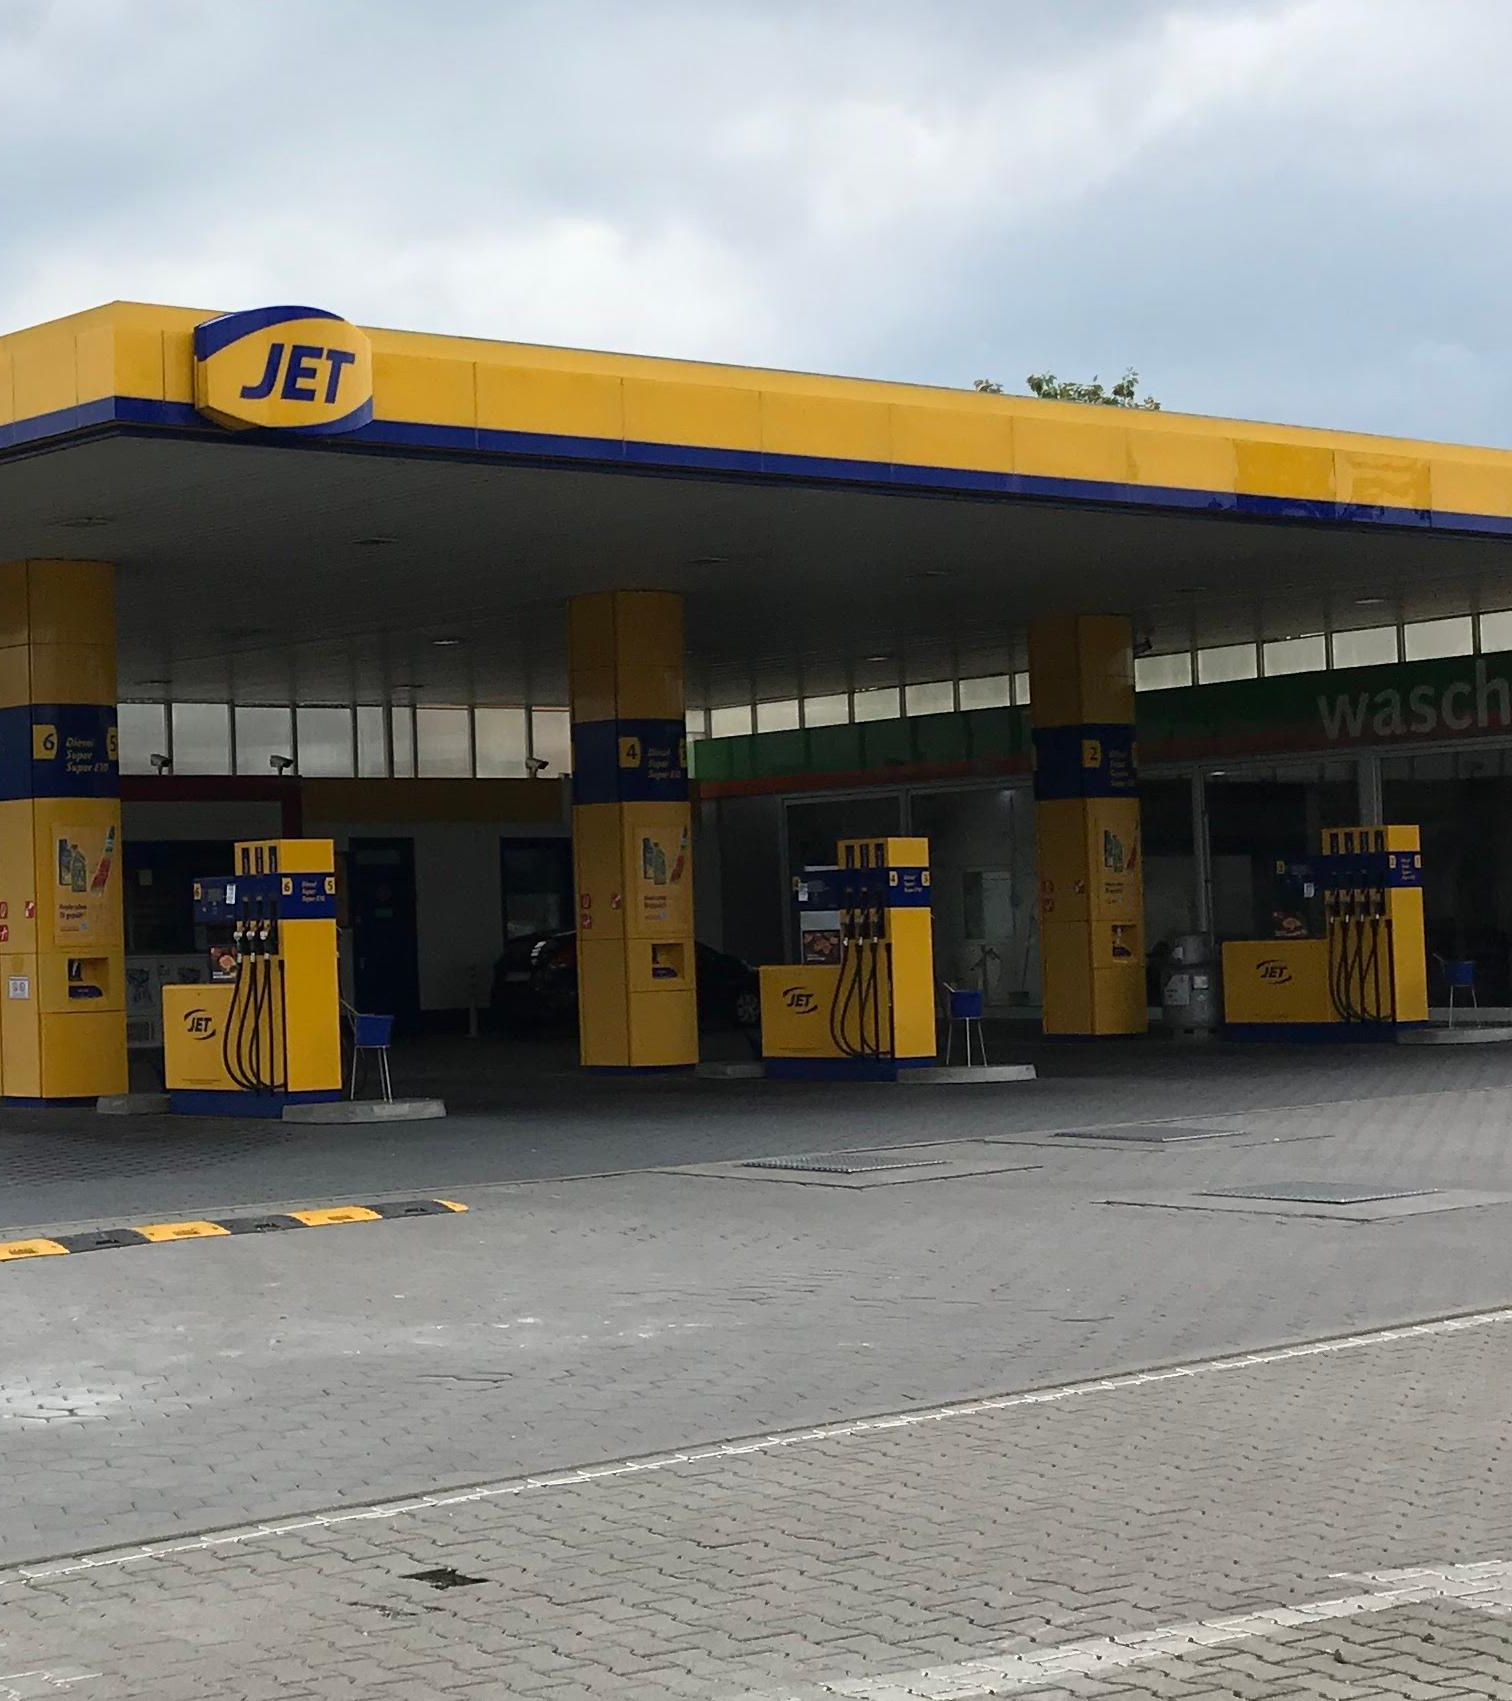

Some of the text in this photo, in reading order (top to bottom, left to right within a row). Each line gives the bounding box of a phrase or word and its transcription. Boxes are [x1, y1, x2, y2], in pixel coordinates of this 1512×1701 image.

[240, 343, 366, 404] JET
[43, 733, 55, 751] 6
[626, 743, 637, 759] 4
[327, 881, 333, 891] 5
[1260, 966, 1288, 978] JET
[787, 994, 814, 1007] JET
[187, 1017, 212, 1032] JET
